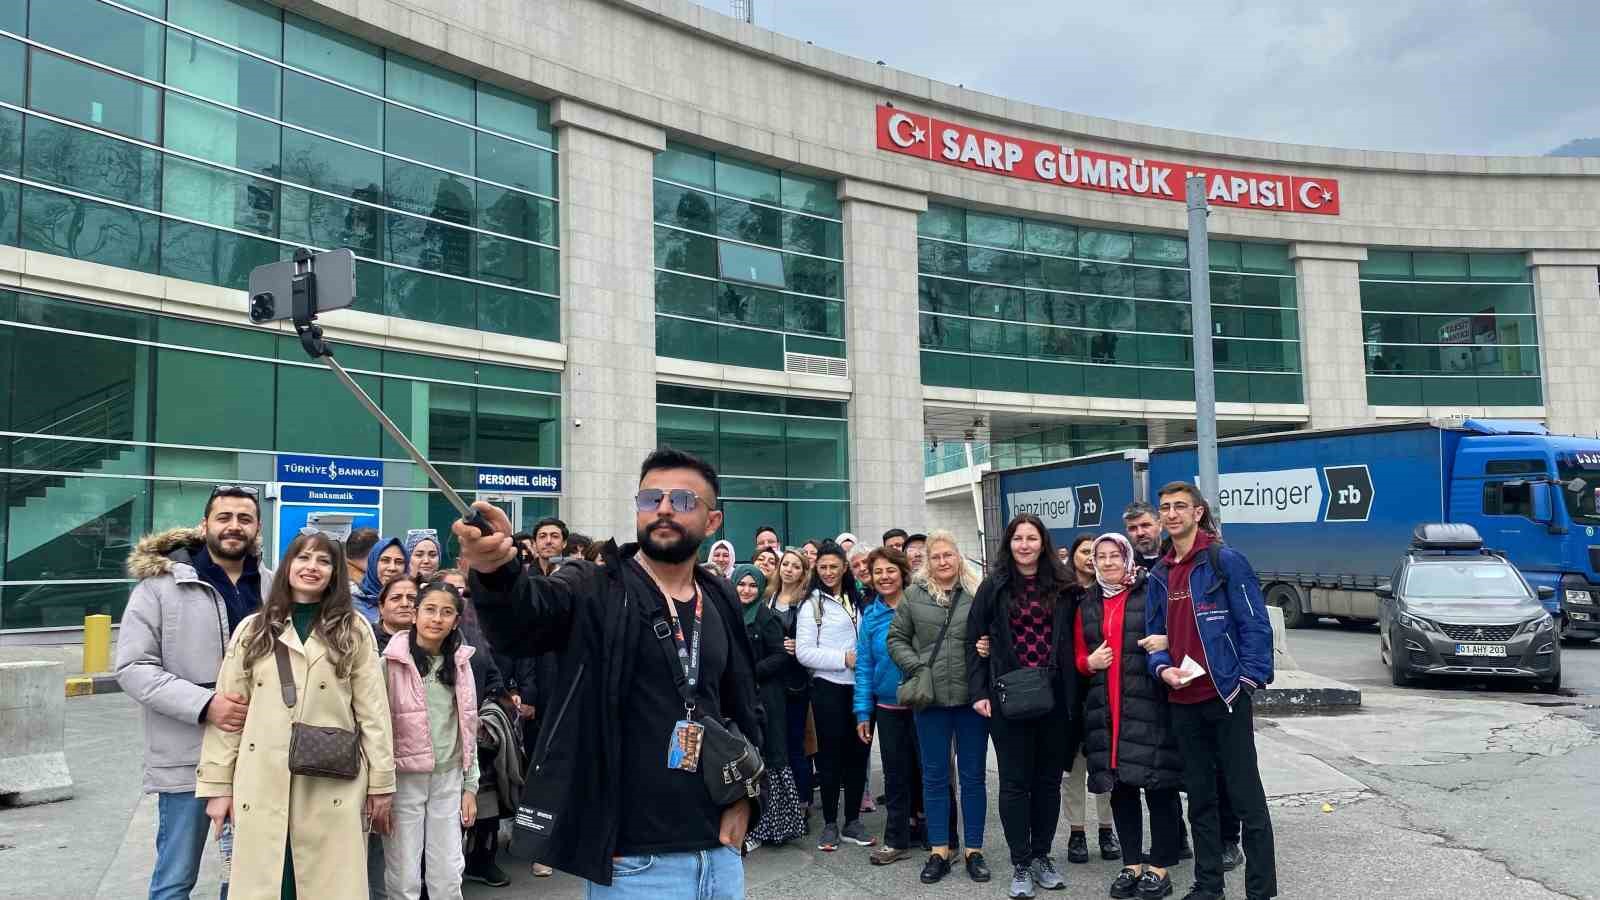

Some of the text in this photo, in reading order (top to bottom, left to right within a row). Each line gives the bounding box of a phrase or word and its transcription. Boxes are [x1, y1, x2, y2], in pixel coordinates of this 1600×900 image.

[941, 128, 1285, 208] SARP GÜMRÜK APISI
[284, 463, 328, 474] TÜRKİYE
[338, 466, 379, 478] BANKASI
[479, 473, 558, 490] PERSONEL GİRİŞ
[308, 490, 354, 501] Bankamatik
[1218, 481, 1313, 511] enzinger
[1338, 484, 1361, 505] rb
[1083, 498, 1097, 515] rb
[1489, 646, 1505, 654] 203
